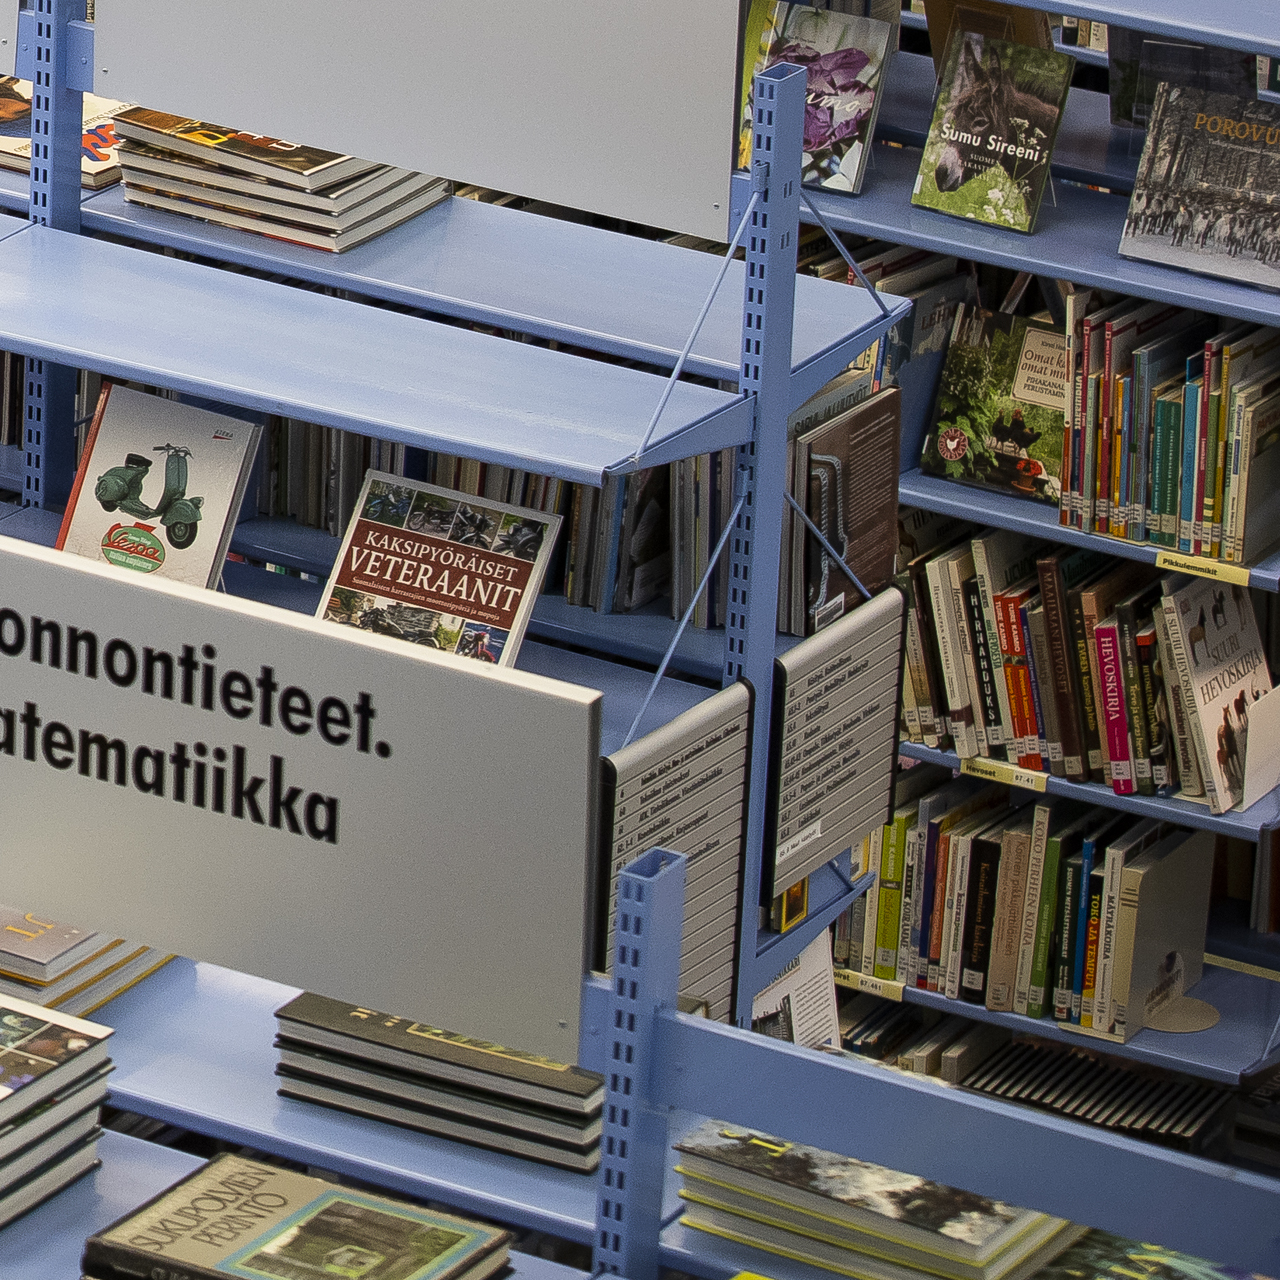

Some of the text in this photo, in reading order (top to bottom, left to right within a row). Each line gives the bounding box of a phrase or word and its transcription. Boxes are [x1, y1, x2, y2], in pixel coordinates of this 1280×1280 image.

[940, 123, 1041, 163] Sumu Sireeni
[103, 523, 161, 559] Vespa
[364, 530, 519, 582] KAKSIPYÖRÄISET
[350, 545, 522, 612] VETERAANIT
[1162, 557, 1218, 578] Pikkulemmikit
[1210, 634, 1238, 668] SUURI
[1101, 635, 1120, 721] HEVOSKIRJA
[1200, 649, 1263, 706] HEVOSKIRJA
[965, 763, 997, 778] Hevoset
[1023, 817, 1046, 947] KOKO PERHEEN KOIRA
[1090, 894, 1100, 926] TOKO
[128, 1164, 279, 1252] SUKUPOLVIEN
